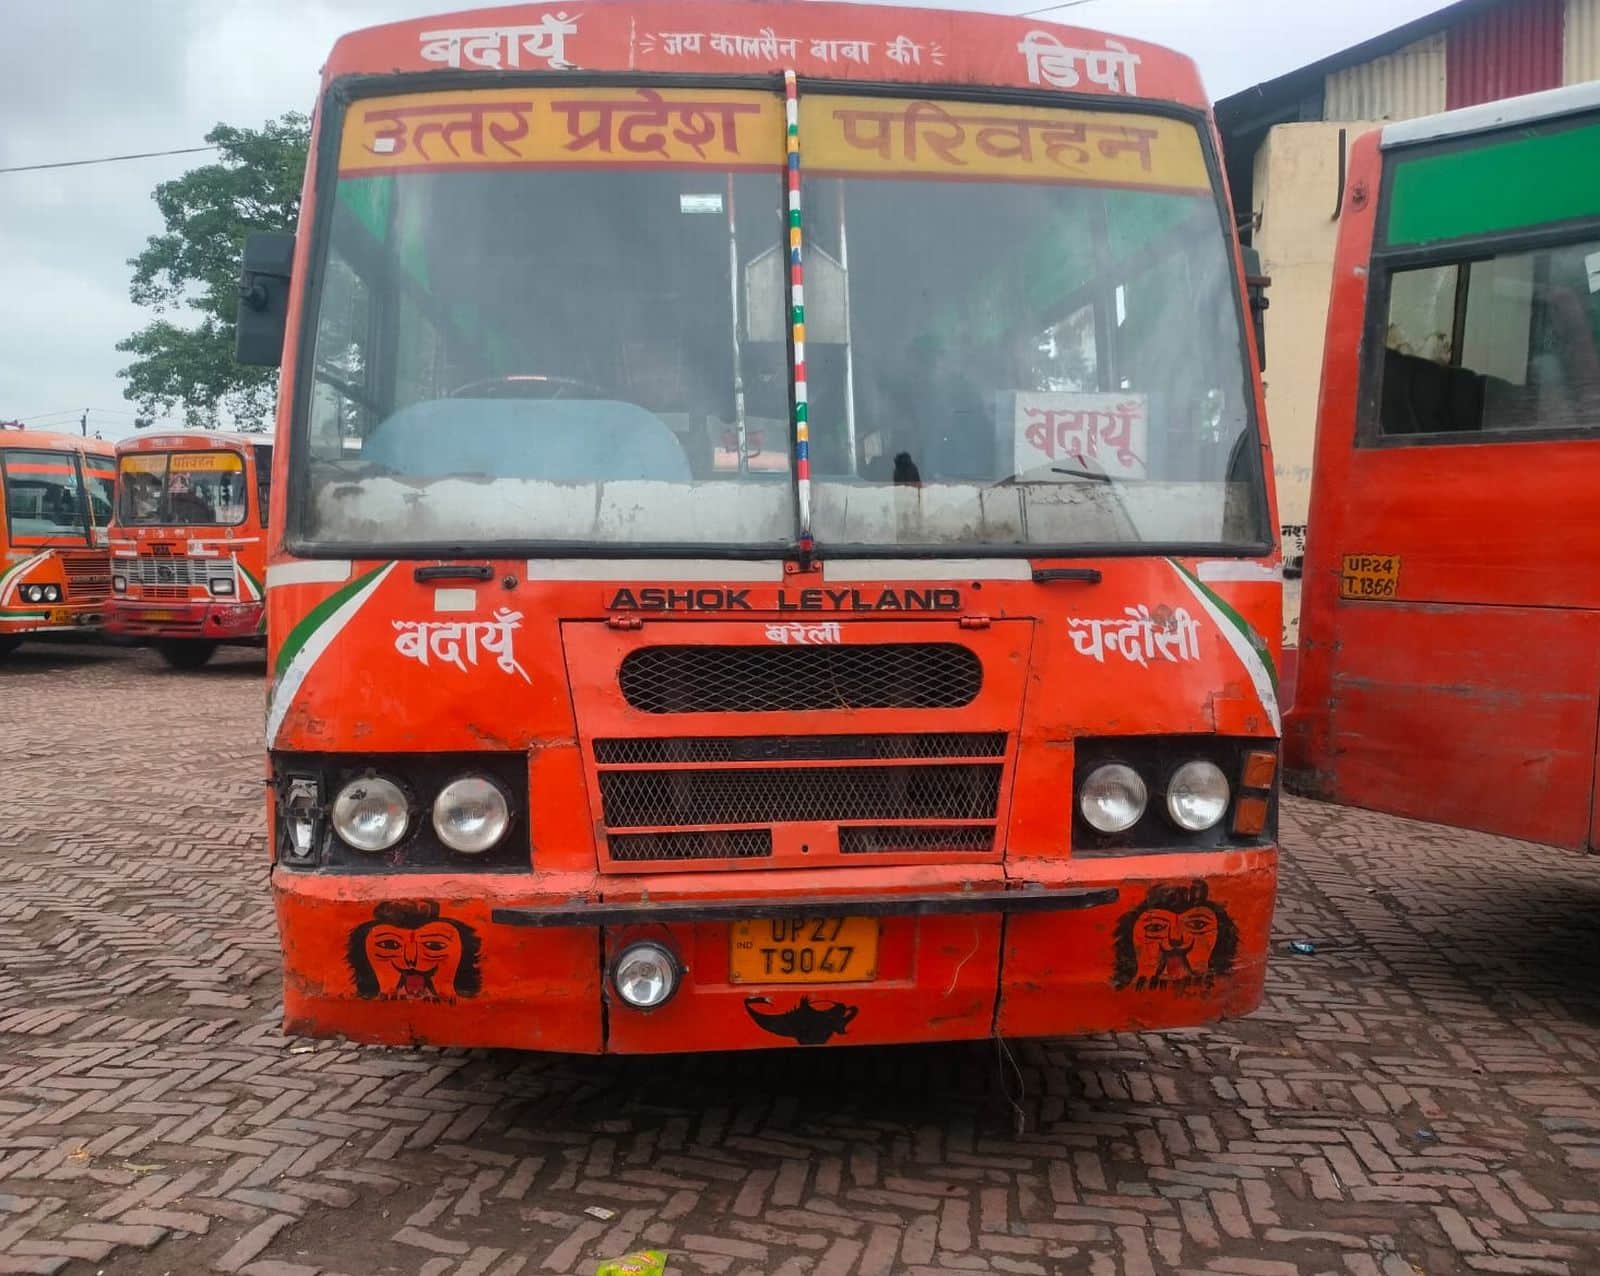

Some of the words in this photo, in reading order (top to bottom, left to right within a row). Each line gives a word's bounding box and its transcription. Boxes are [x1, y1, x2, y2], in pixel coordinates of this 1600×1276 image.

[419, 11, 584, 70] बदायूँ
[659, 32, 704, 57] जय
[810, 38, 876, 65] बाबा
[886, 34, 924, 65] की
[1018, 30, 1141, 96] डिपो
[362, 101, 534, 161] उत्तर
[550, 89, 761, 159] प्रदेश
[832, 101, 1159, 172] परिवहन
[610, 588, 752, 611] ASHOK
[778, 588, 961, 610] LEYLAND
[391, 607, 534, 685] बदायूँ
[764, 621, 844, 645] बरेली
[771, 917, 846, 942] UP27
[760, 945, 855, 975] T9047
